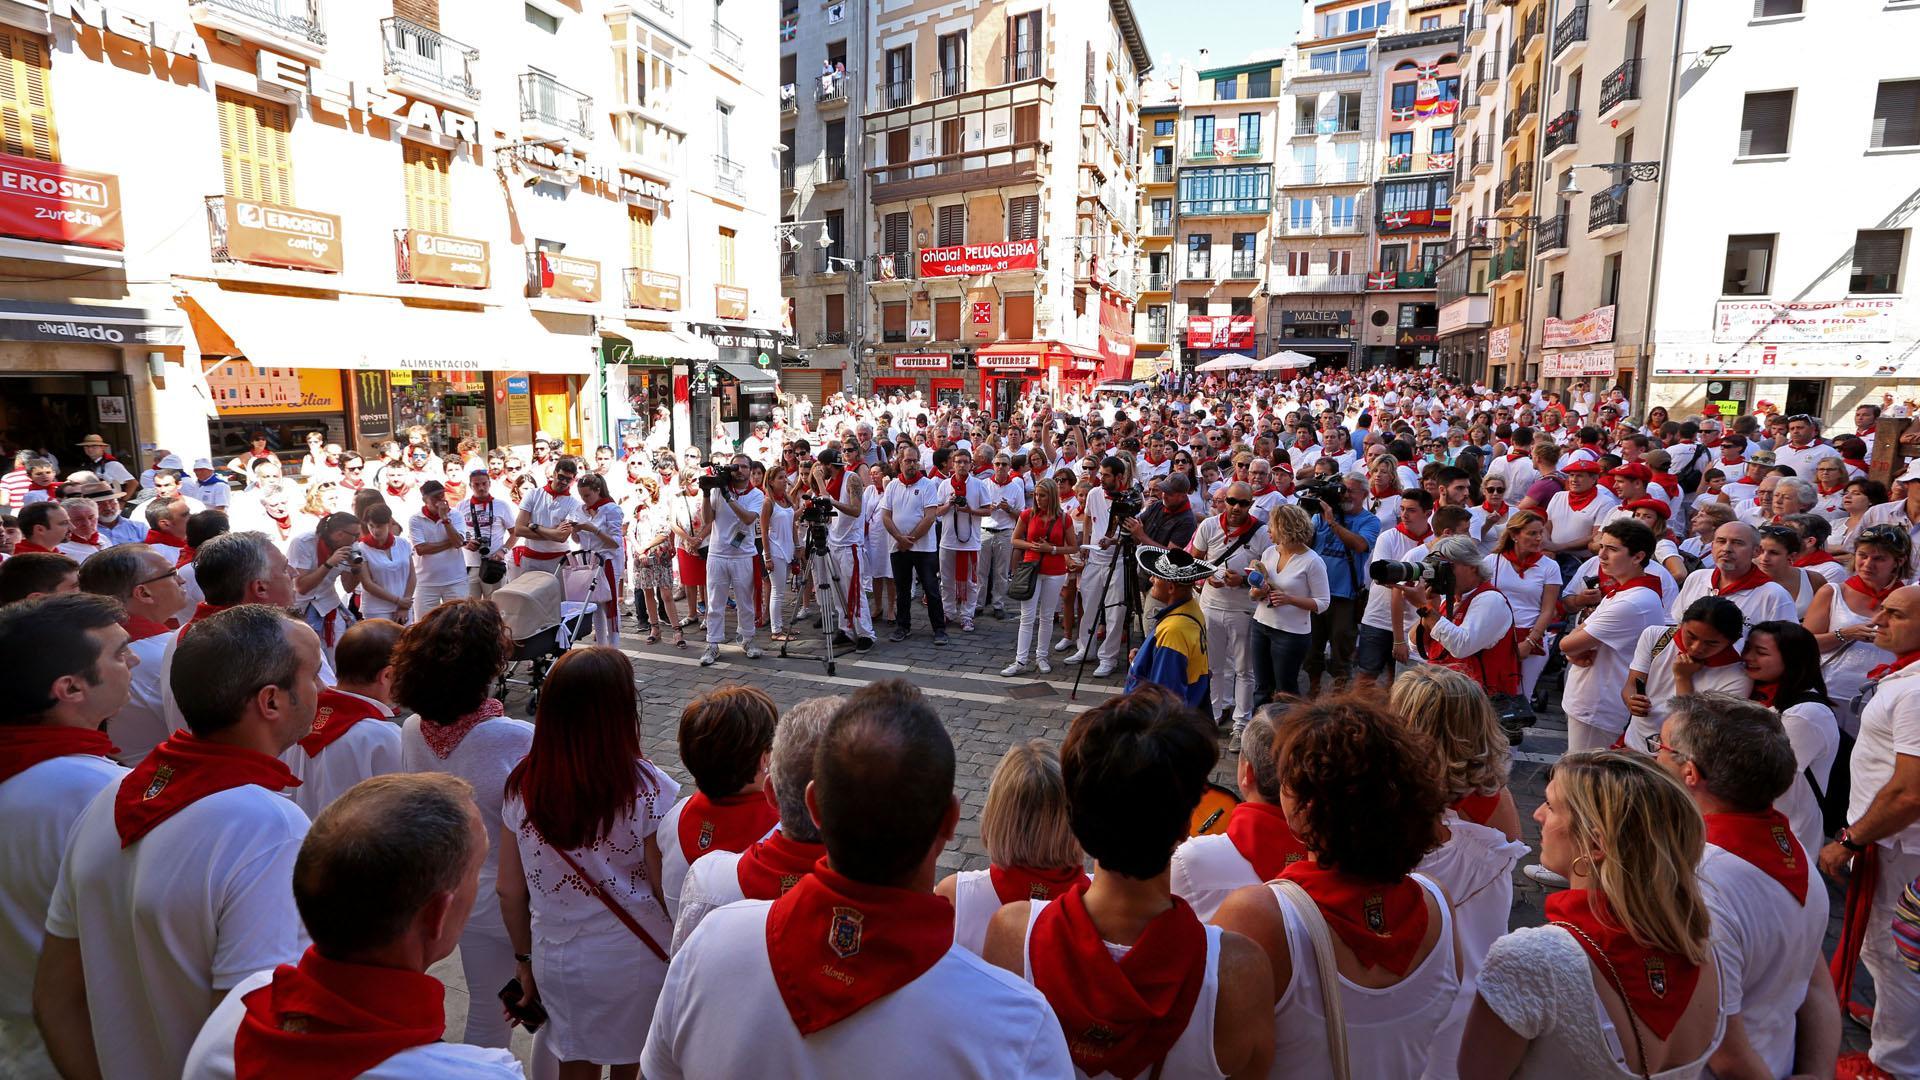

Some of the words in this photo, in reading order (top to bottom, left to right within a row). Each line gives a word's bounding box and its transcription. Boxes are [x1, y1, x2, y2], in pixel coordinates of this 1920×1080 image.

[2, 171, 100, 202] EROSKI
[267, 211, 329, 236] EROSKI
[287, 236, 329, 258] contigo
[922, 248, 960, 263] ohlala!
[965, 242, 1035, 260] PELUQUERIA
[1294, 311, 1338, 320] MALTEA
[1823, 324, 1854, 335] BEER
[735, 336, 741, 347] Y
[399, 359, 479, 369] ALIMENTACION
[902, 358, 940, 366] GUTIERREZ
[986, 356, 1031, 365] GUTIERREZ
